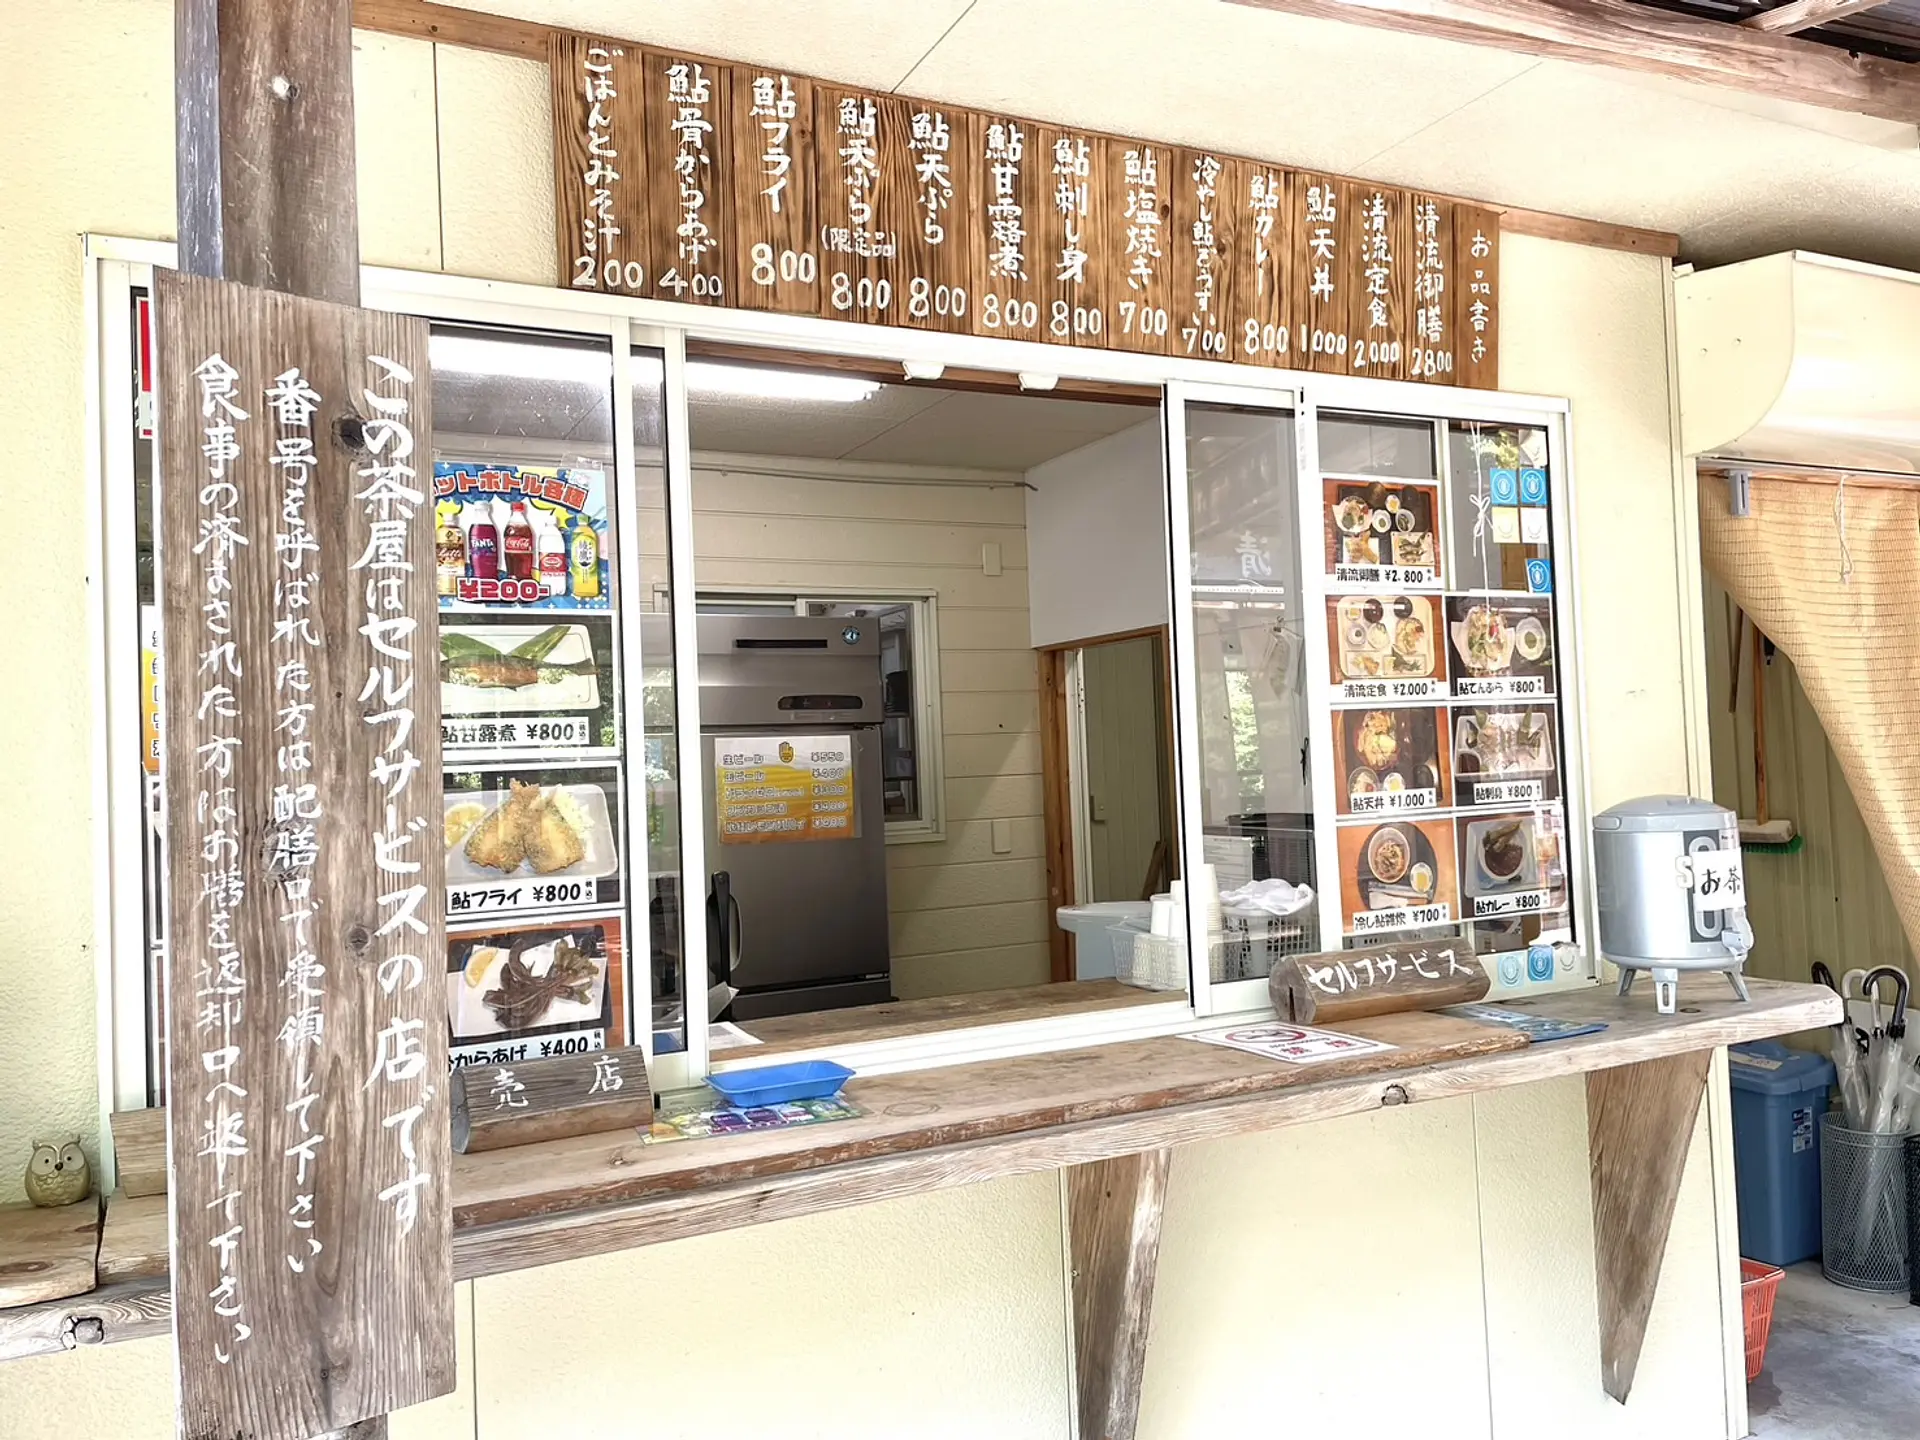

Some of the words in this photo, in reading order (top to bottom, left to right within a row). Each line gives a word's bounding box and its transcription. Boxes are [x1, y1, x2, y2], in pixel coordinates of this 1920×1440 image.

[584, 47, 623, 254] ごはんとみそ汁
[749, 75, 797, 213] 鮎フライ
[838, 97, 881, 224] 鮎天ぷら
[665, 64, 716, 265] 鮎骨からあげ
[907, 113, 953, 245] 鮎天ぷら
[985, 122, 1028, 281] 鮎甘露煮
[1052, 138, 1090, 284] 鮎刺し身
[1123, 148, 1161, 291] 鮎塩焼き
[821, 224, 897, 259] (限定品)
[1192, 157, 1221, 327] 冷やし鮎ぞうすい
[1249, 173, 1279, 297] 鮎カレー
[1305, 184, 1336, 303] 鮎天丼
[572, 255, 644, 289] 200
[750, 242, 817, 286] 800
[1362, 192, 1392, 329] 清流定食
[1415, 200, 1444, 343] 清流御膳
[659, 268, 723, 297] 400
[831, 272, 891, 310] 800
[909, 277, 966, 317] 800
[1469, 231, 1492, 363] お品書き
[982, 294, 1037, 328] 800
[1050, 301, 1101, 336] 800
[1119, 301, 1167, 336] 700
[1182, 329, 1226, 354] 700
[1244, 318, 1289, 355] 800
[1301, 324, 1347, 356] 1000
[1354, 339, 1400, 368] 2000
[1411, 349, 1452, 377] 2800
[434, 470, 589, 510] ットボトル各種
[1510, 680, 1535, 693] ¥800
[526, 722, 574, 741] ¥800
[350, 354, 433, 1240] この茶屋はセルフサービスの店です
[1508, 785, 1533, 798] ¥800
[451, 888, 522, 909] 鮎フライ
[533, 883, 581, 901] ¥800
[1700, 868, 1742, 896] お茶
[1413, 908, 1440, 923] ¥700
[1515, 895, 1541, 908] ¥800
[1307, 949, 1473, 995] セルフサービス
[540, 1037, 589, 1058] ¥400
